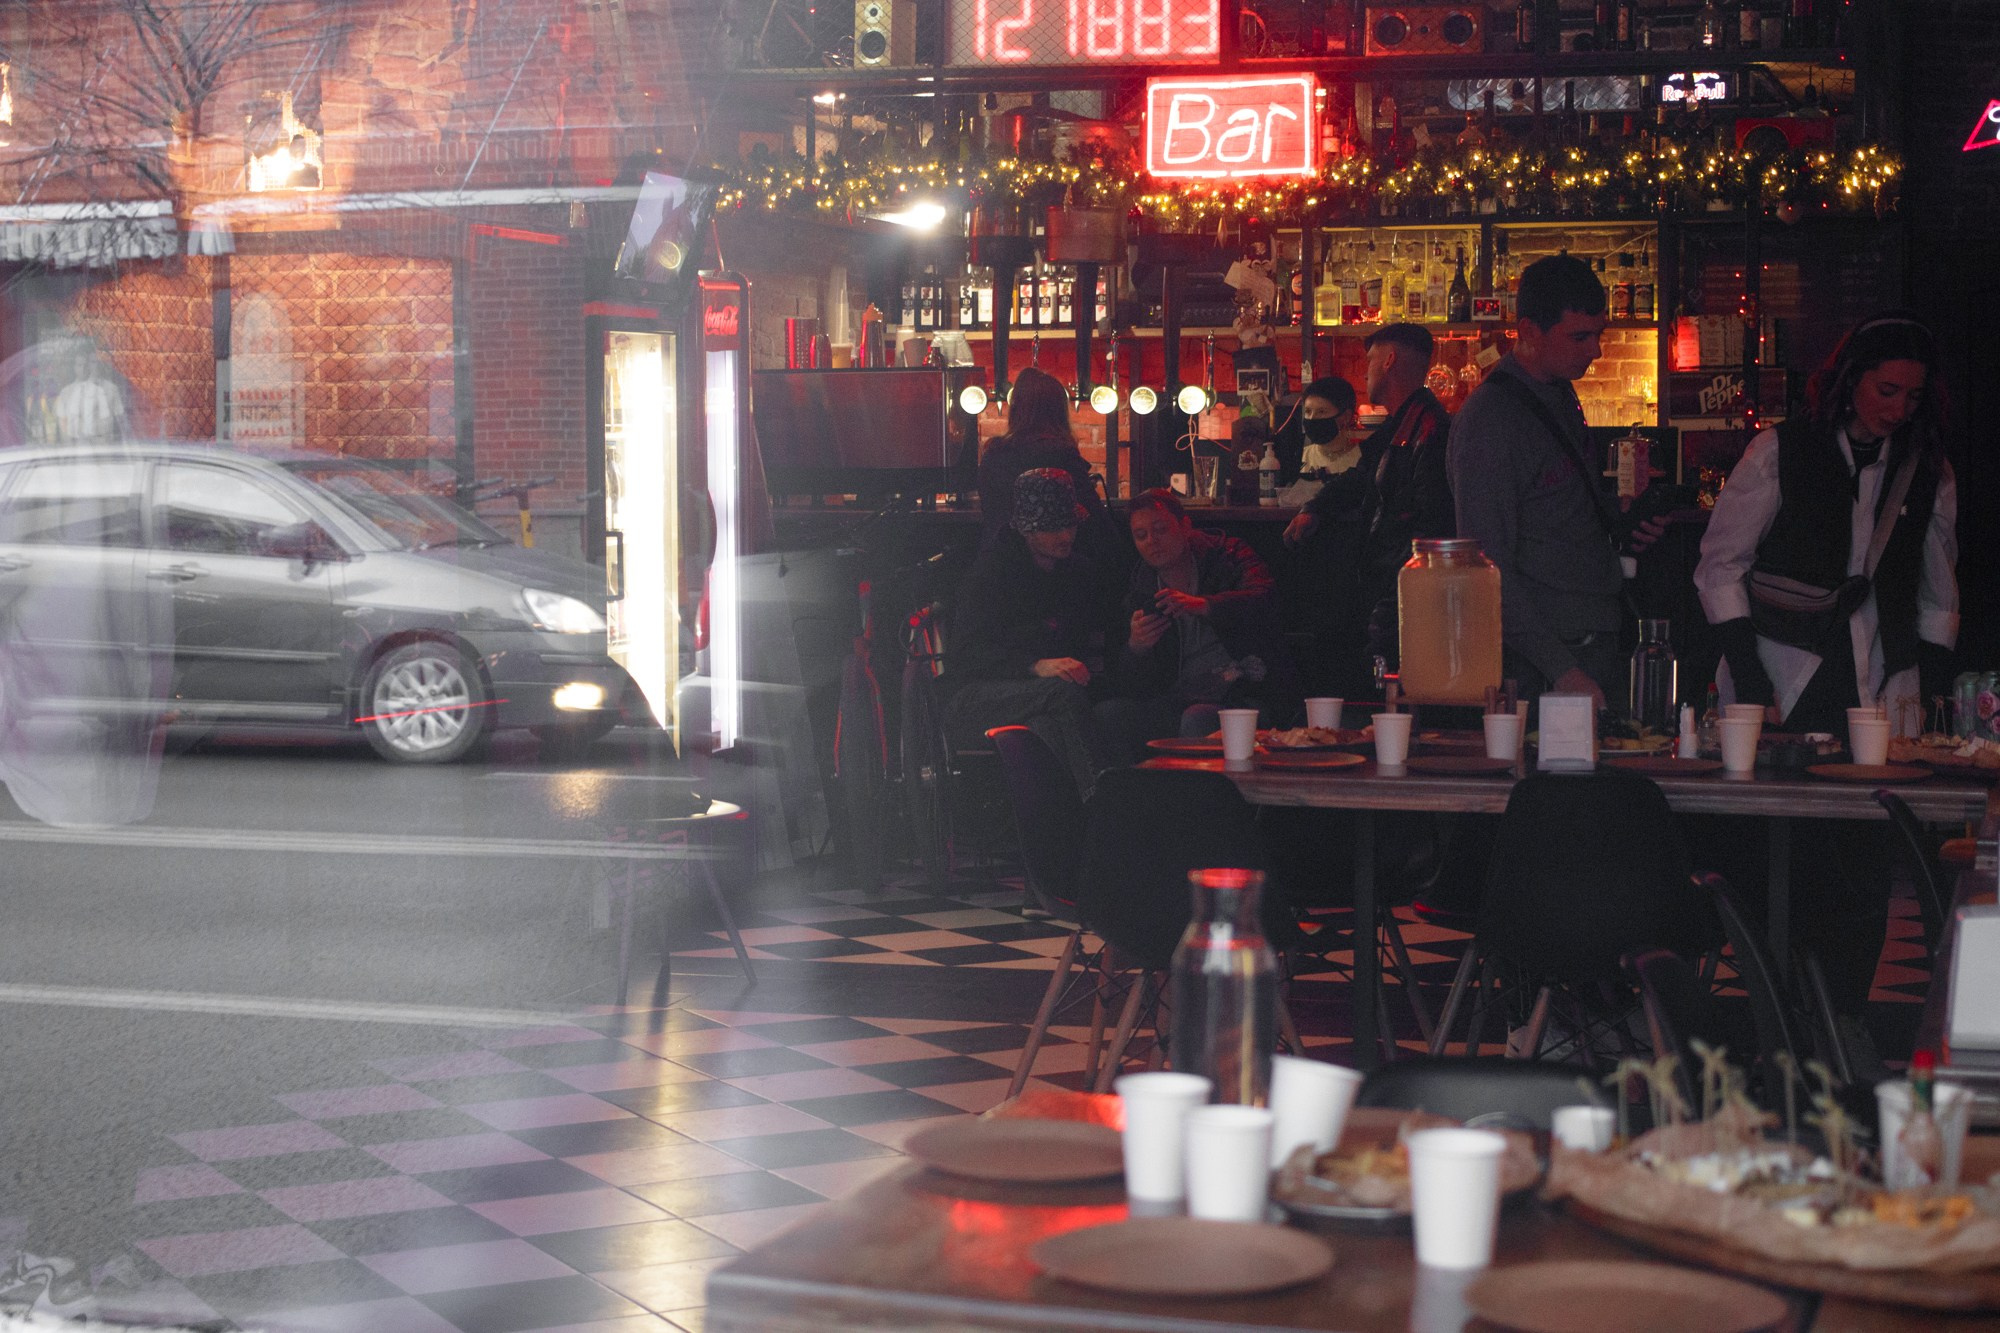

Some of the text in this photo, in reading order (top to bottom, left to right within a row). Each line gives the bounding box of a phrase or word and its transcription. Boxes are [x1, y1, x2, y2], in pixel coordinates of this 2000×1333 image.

[1662, 81, 1726, 101] Re Bull
[1163, 93, 1297, 164] Bar
[1698, 379, 1745, 415] Peppe
[1713, 374, 1733, 392] Dr
